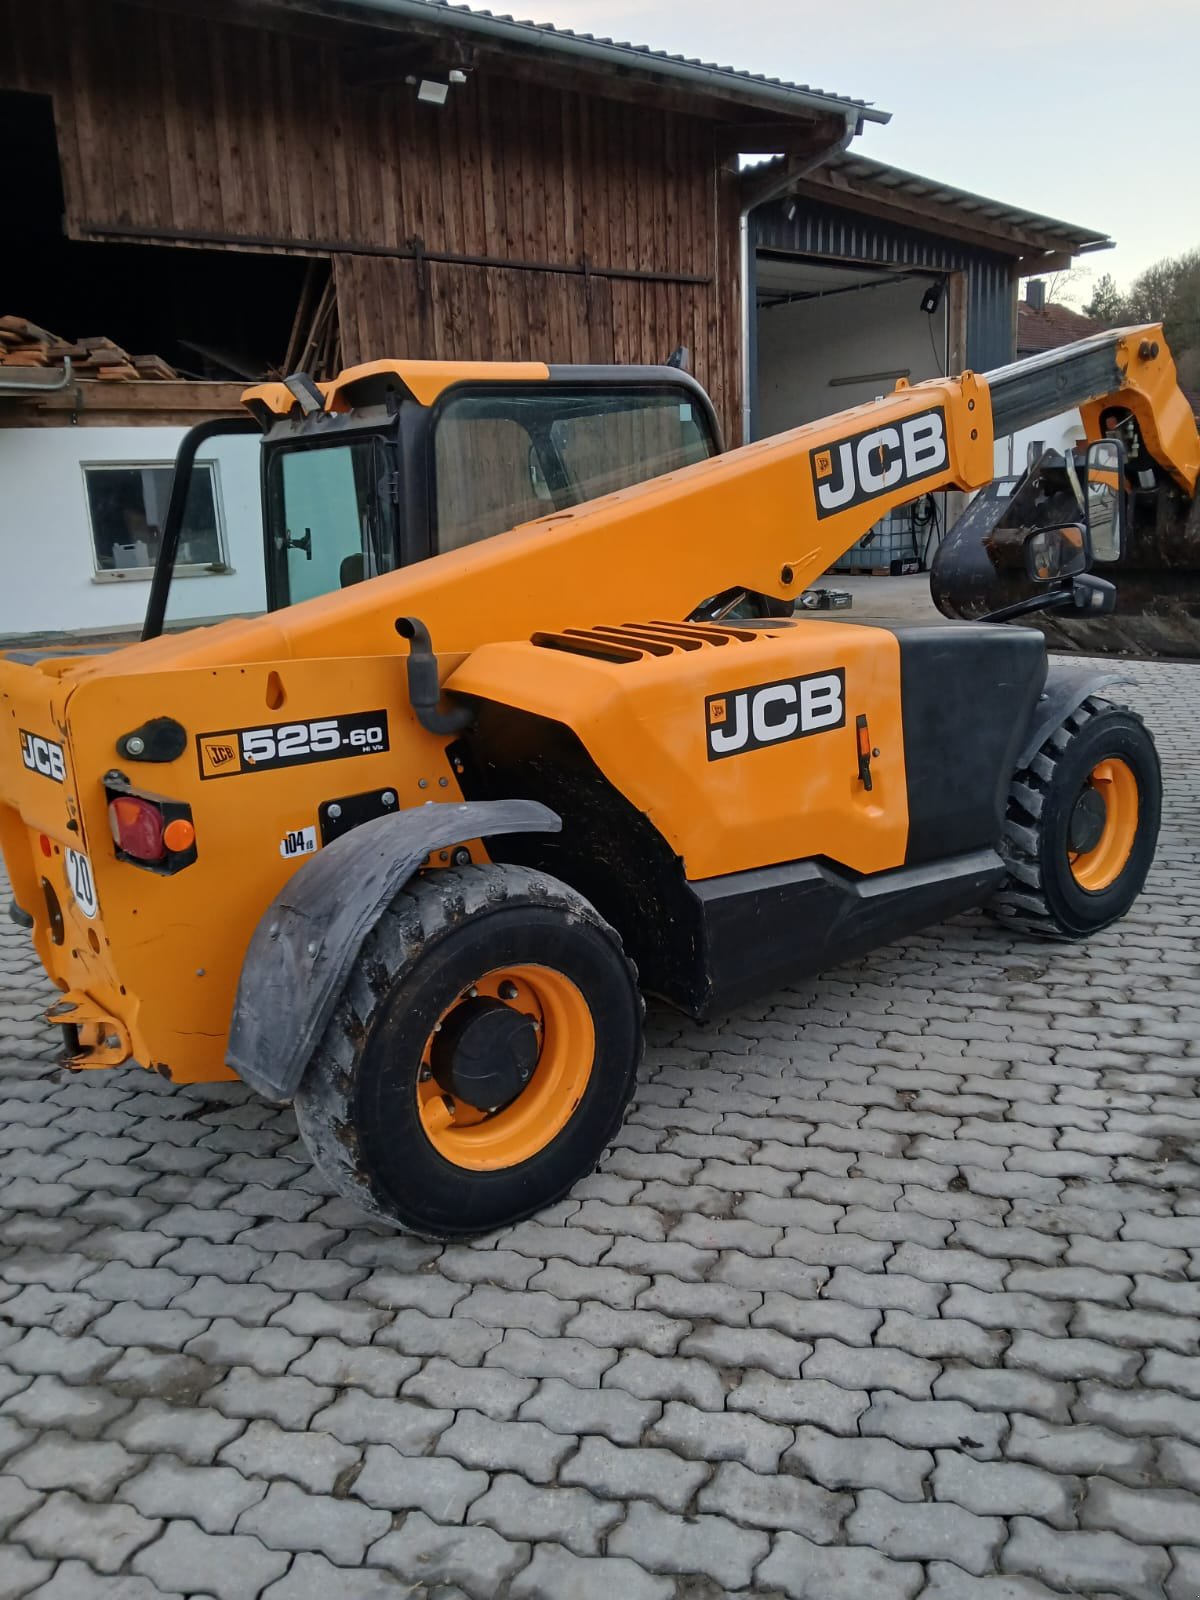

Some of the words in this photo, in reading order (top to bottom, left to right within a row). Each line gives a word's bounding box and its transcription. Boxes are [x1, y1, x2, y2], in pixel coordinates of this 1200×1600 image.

[818, 413, 946, 509] JCB
[710, 674, 843, 753] JCB
[22, 734, 66, 781] JCB
[209, 747, 234, 764] JCB
[282, 831, 305, 855] 104
[69, 850, 93, 906] 20
